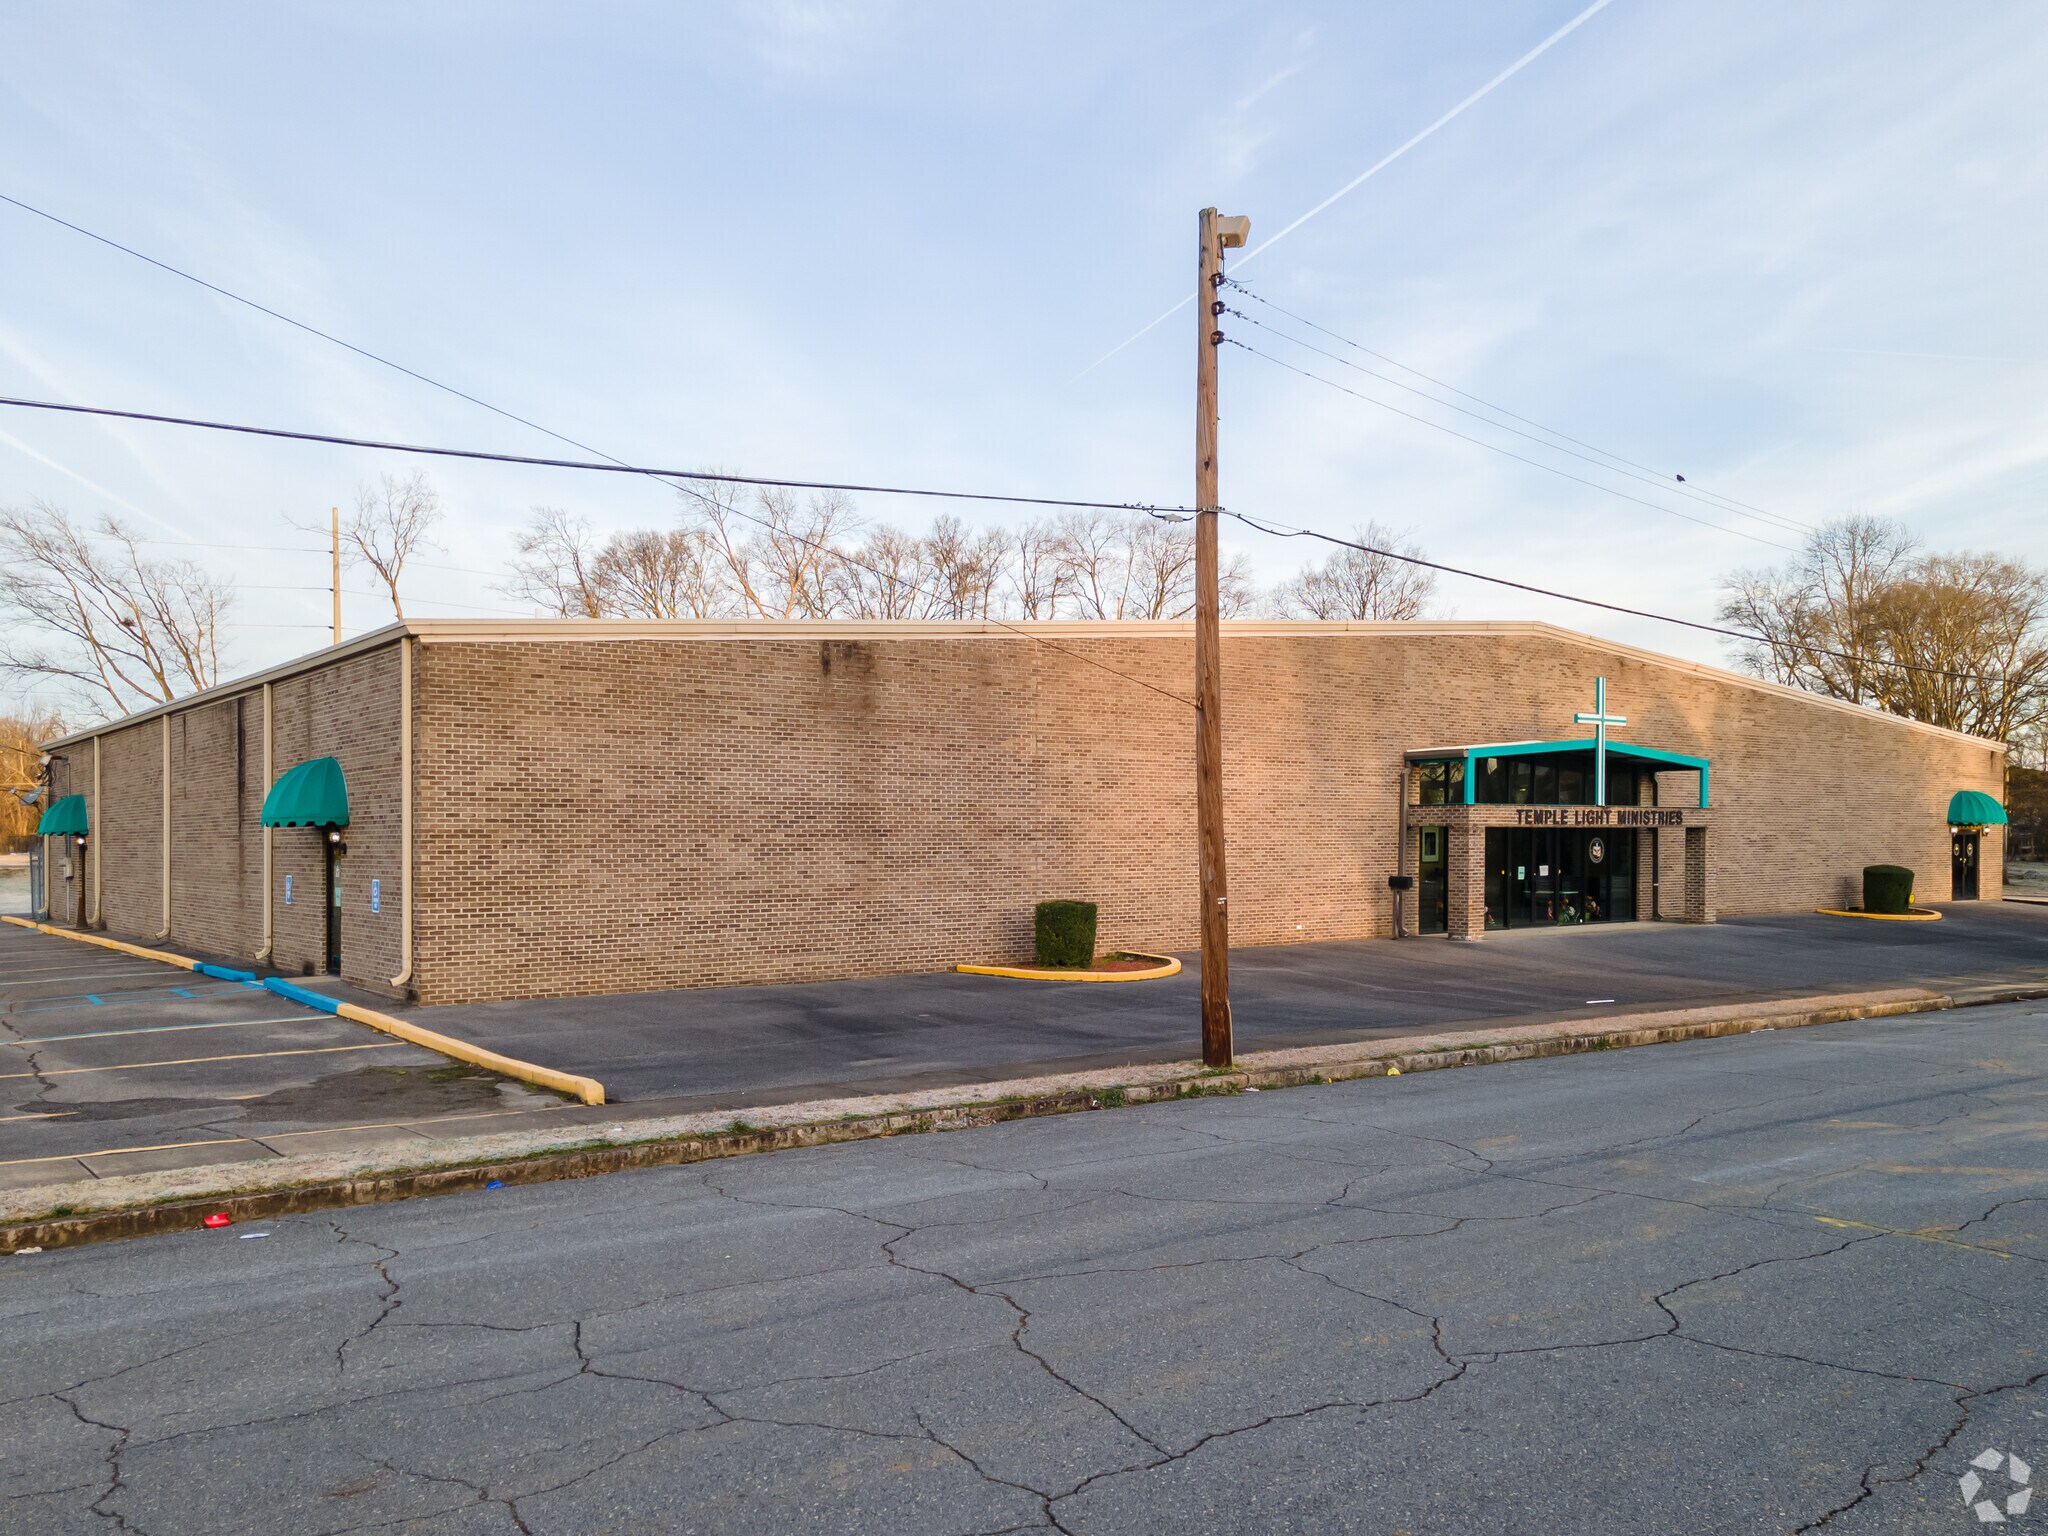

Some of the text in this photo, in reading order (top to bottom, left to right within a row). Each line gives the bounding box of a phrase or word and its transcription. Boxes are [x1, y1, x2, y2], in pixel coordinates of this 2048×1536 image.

[1516, 809, 1683, 826] TEMPLE LIGHT MINISTRIES
